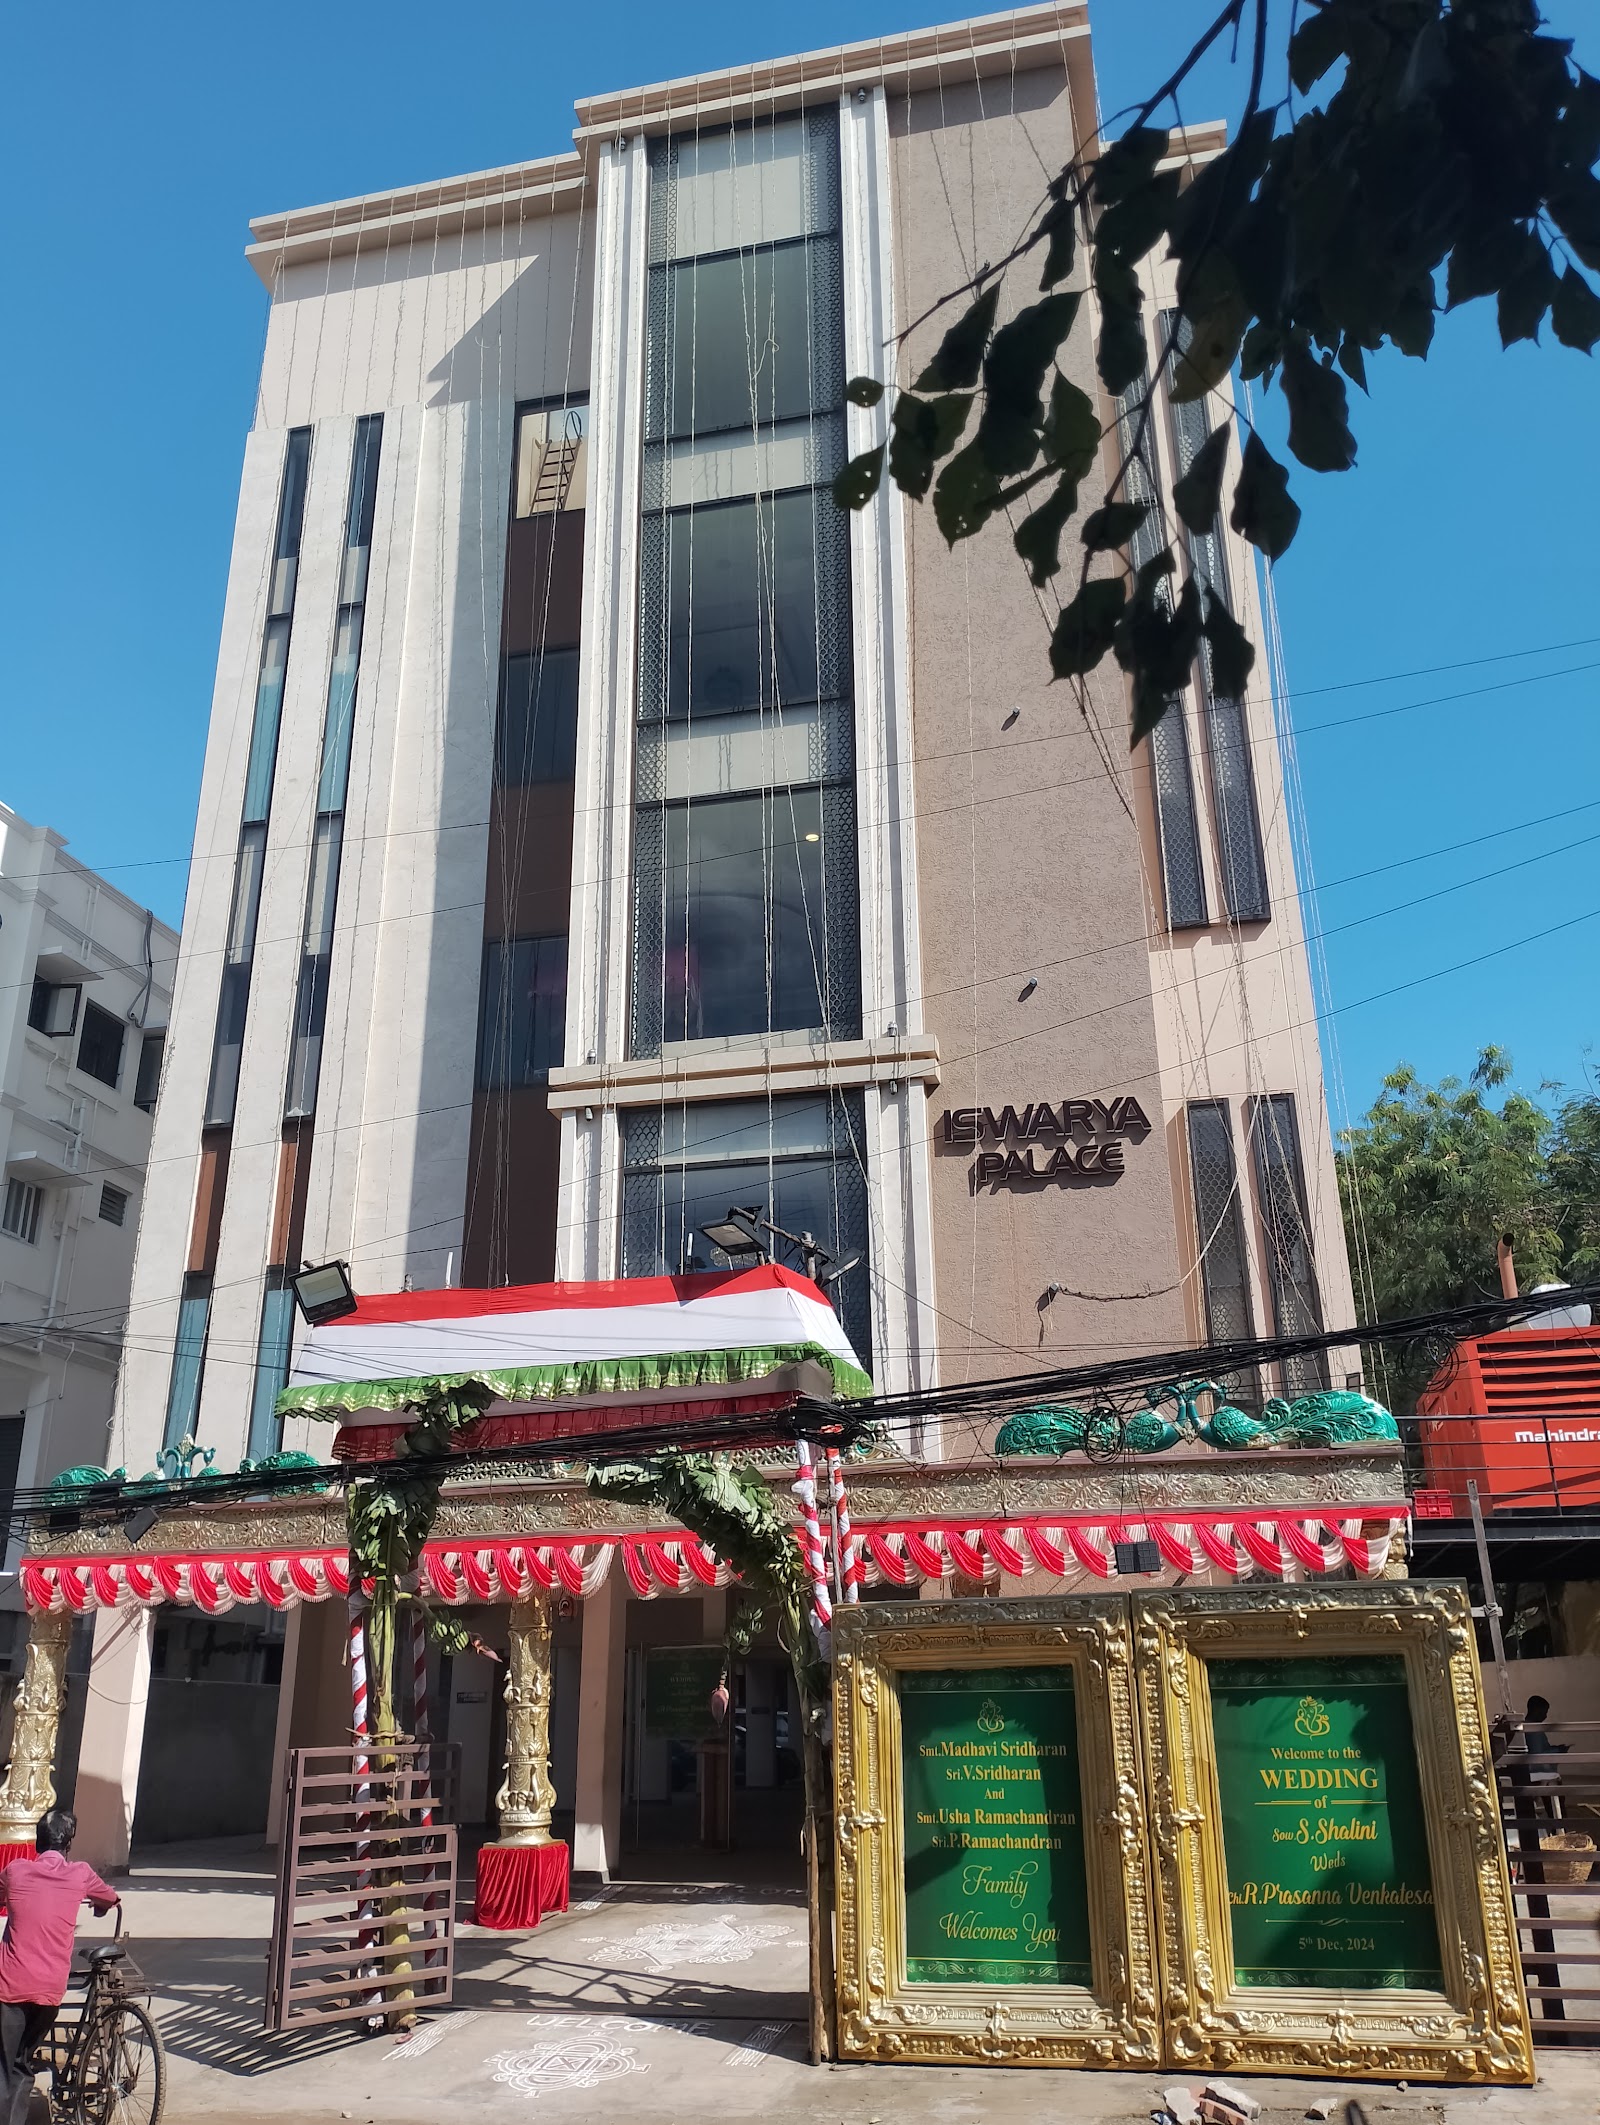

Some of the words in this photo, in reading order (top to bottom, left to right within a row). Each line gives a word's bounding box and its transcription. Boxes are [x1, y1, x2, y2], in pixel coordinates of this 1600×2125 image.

[943, 1096, 1152, 1144] ISWARYA
[977, 1141, 1125, 1183] PALACE
[1514, 1428, 1600, 1443] Mahindr
[919, 1741, 998, 1757] Smt.Madhavi
[1000, 1741, 1067, 1756] Sridharan
[1270, 1747, 1325, 1760] Welcome
[1328, 1748, 1340, 1759] to
[1343, 1747, 1362, 1759] the
[945, 1765, 1041, 1781] Sri.V.Sridharan
[1260, 1767, 1378, 1790] WEDDING
[984, 1787, 1005, 1800] And
[1313, 1795, 1329, 1809] of
[916, 1808, 971, 1825] Smt.Usha
[974, 1808, 1076, 1826] Ramachandran
[931, 1833, 1062, 1850] Sri.P.Ramachandran
[1310, 1850, 1346, 1872] Weds
[962, 1861, 1039, 1908] Family
[1345, 1881, 1434, 1905] Venkatesa
[939, 1911, 1018, 1941] Welcomes
[1022, 1912, 1061, 1952] You
[1298, 1936, 1313, 1950] 5th
[1346, 1937, 1375, 1951] 2024
[526, 2013, 715, 2036] WELCOME
